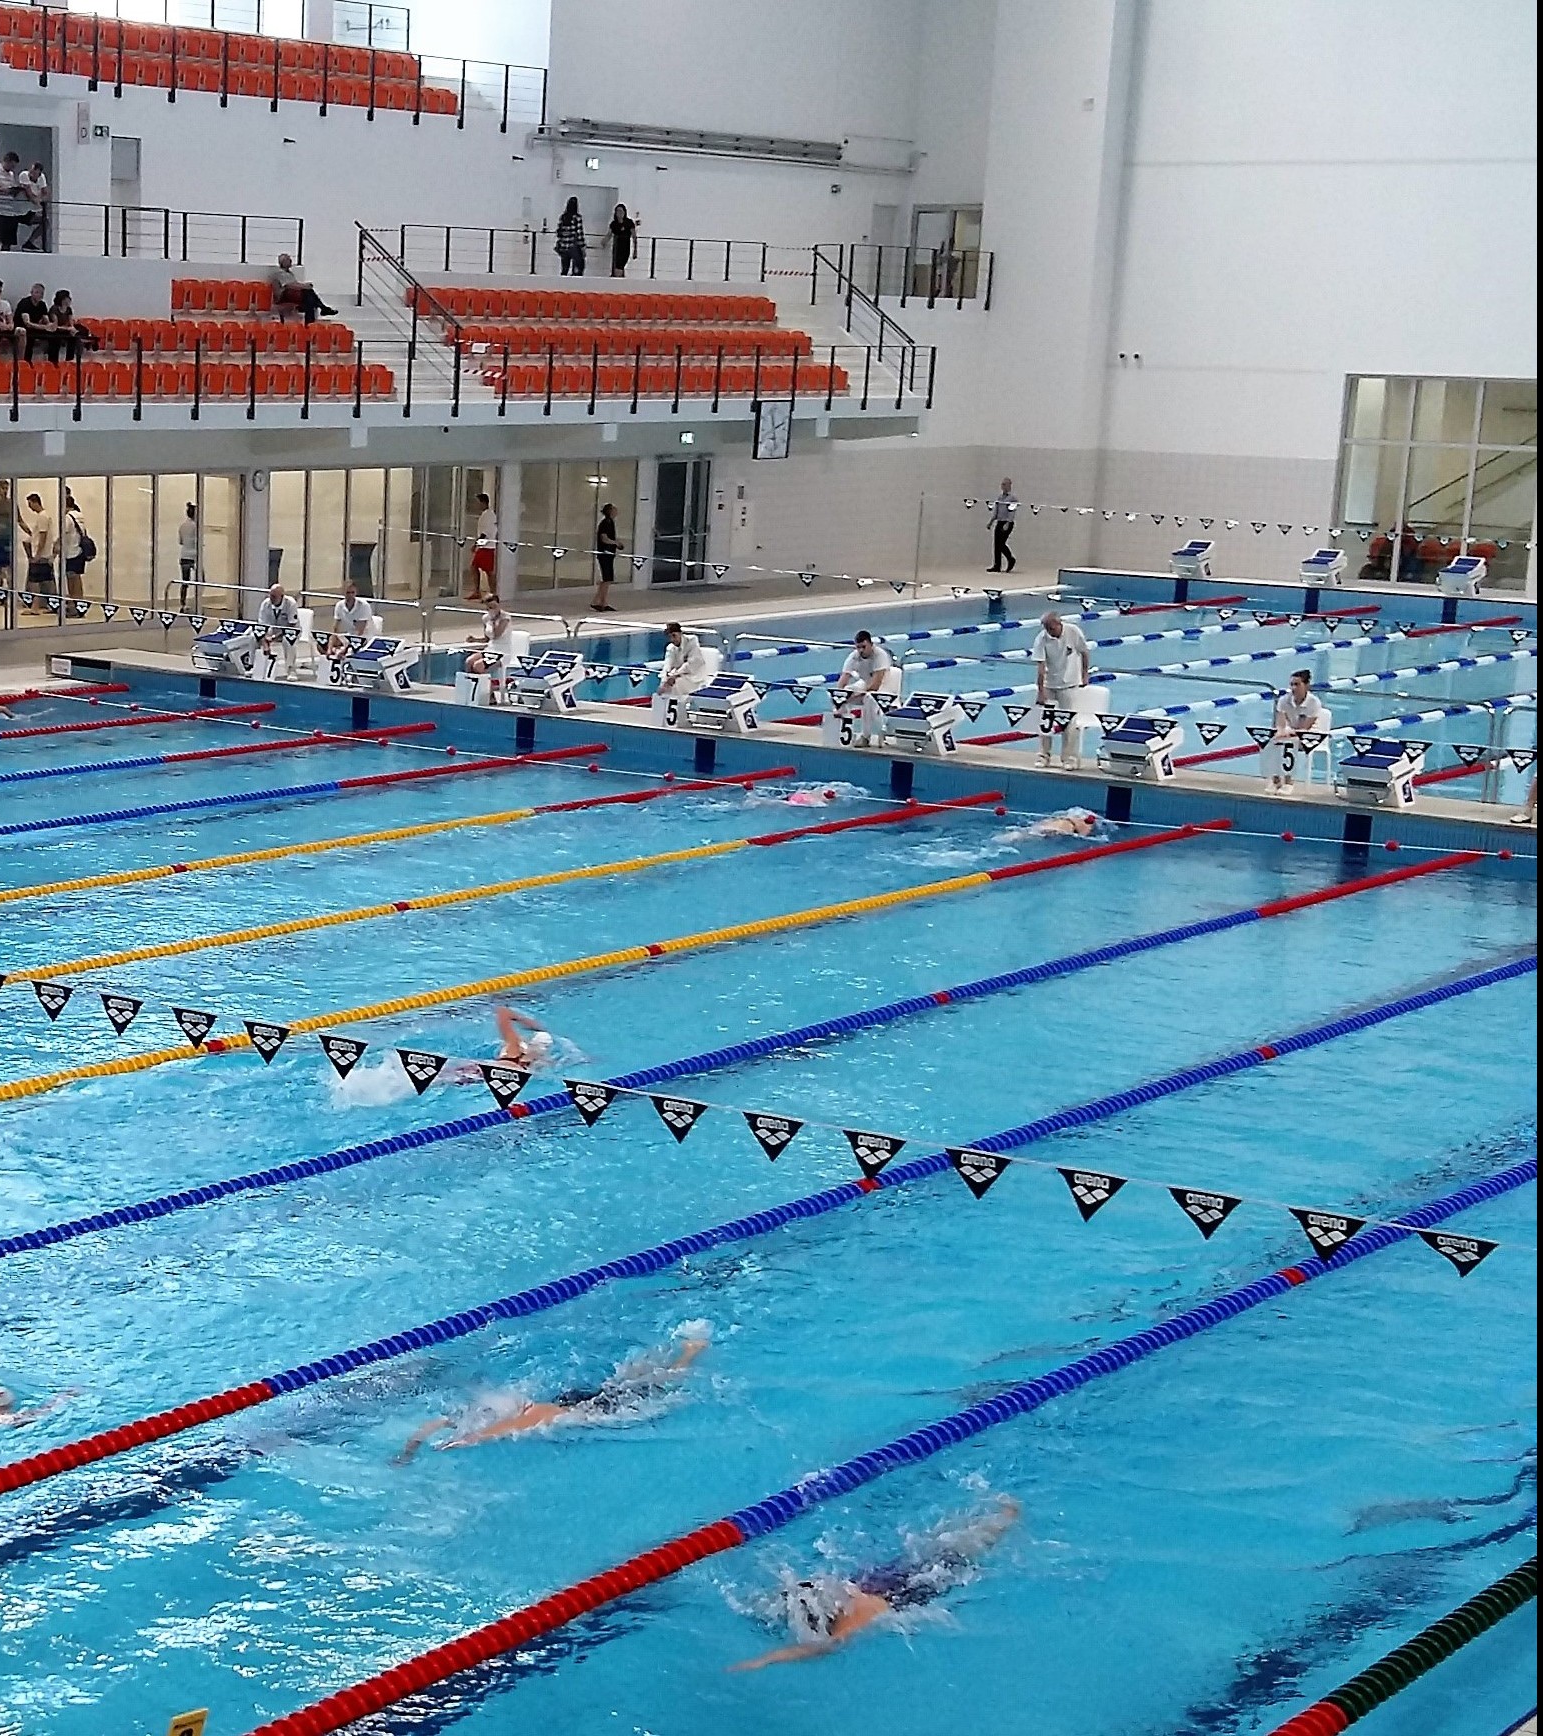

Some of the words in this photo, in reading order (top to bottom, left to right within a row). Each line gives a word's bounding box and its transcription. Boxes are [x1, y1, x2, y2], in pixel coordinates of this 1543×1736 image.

[329, 659, 341, 683] 5
[398, 673, 405, 686] 8
[467, 677, 479, 702] 7
[665, 698, 678, 726] 5
[839, 718, 853, 745] 5
[1282, 743, 1294, 772] 5
[1073, 1172, 1110, 1189] arena
[1185, 1192, 1224, 1210] arena
[1307, 1213, 1347, 1231] arena
[1436, 1235, 1478, 1252] arena
